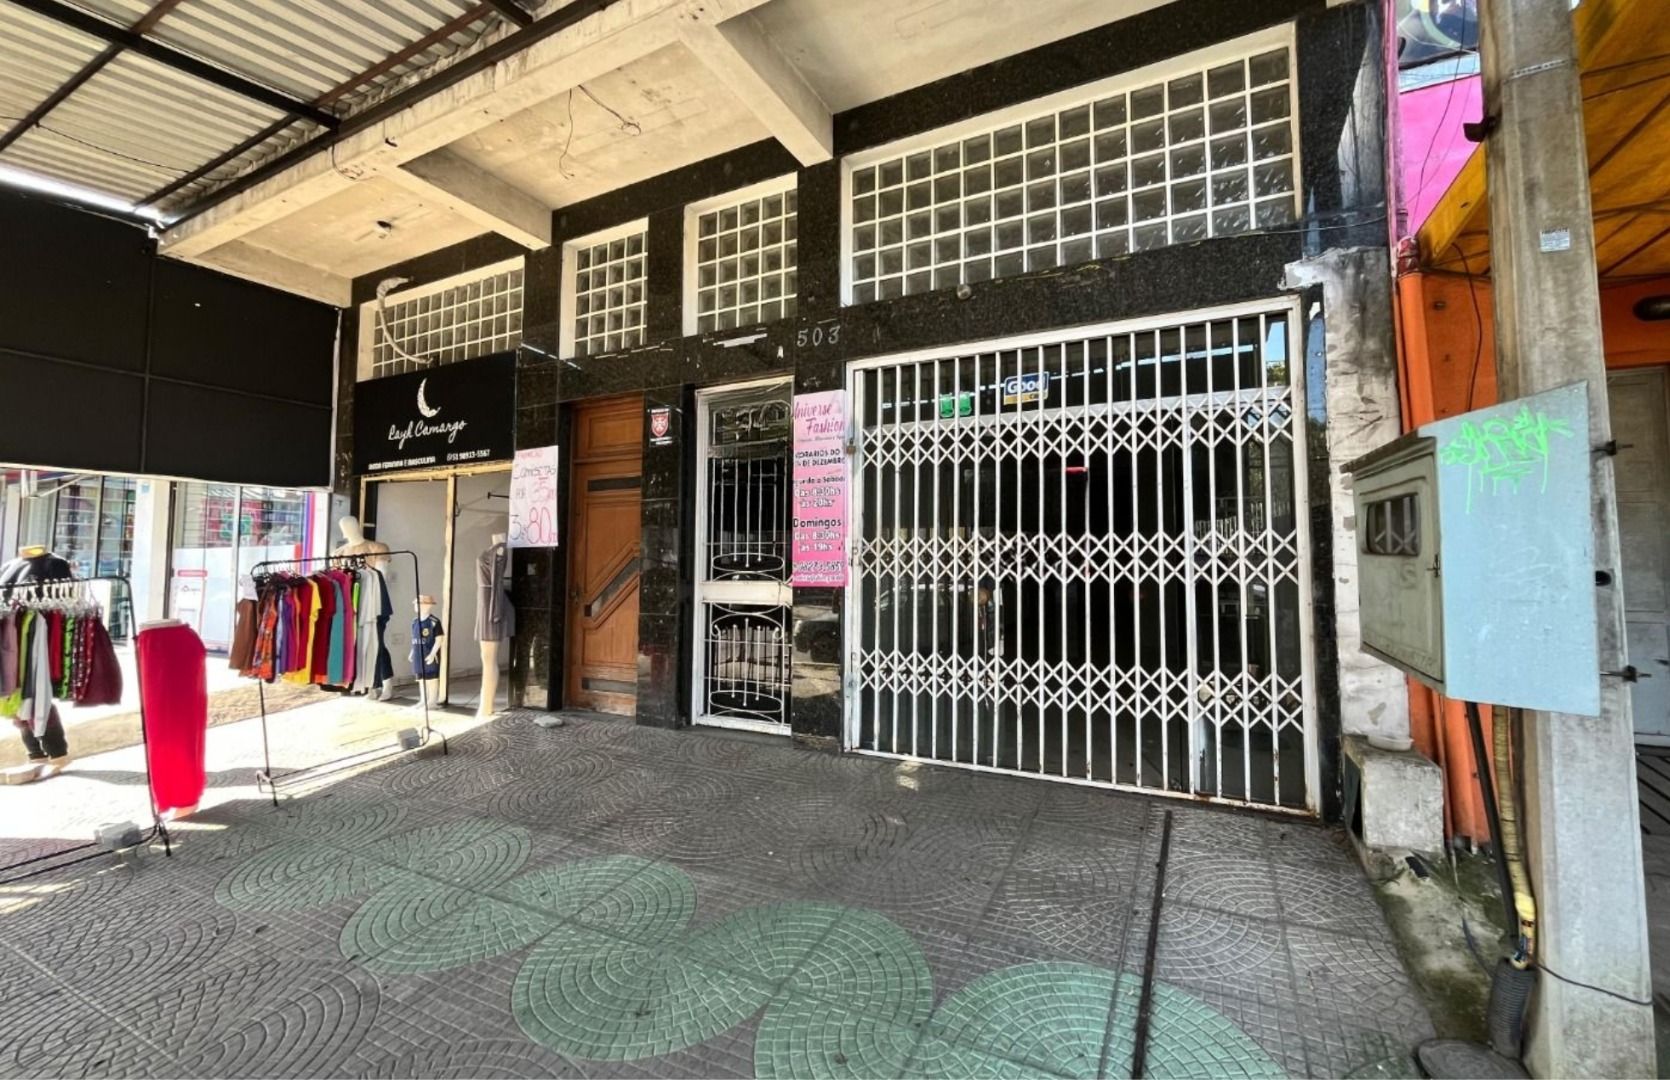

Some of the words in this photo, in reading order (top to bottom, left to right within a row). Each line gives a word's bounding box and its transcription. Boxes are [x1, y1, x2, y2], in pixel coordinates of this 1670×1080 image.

[796, 324, 841, 347] 503
[414, 419, 468, 444] Camargo
[793, 517, 842, 530] Domingos
